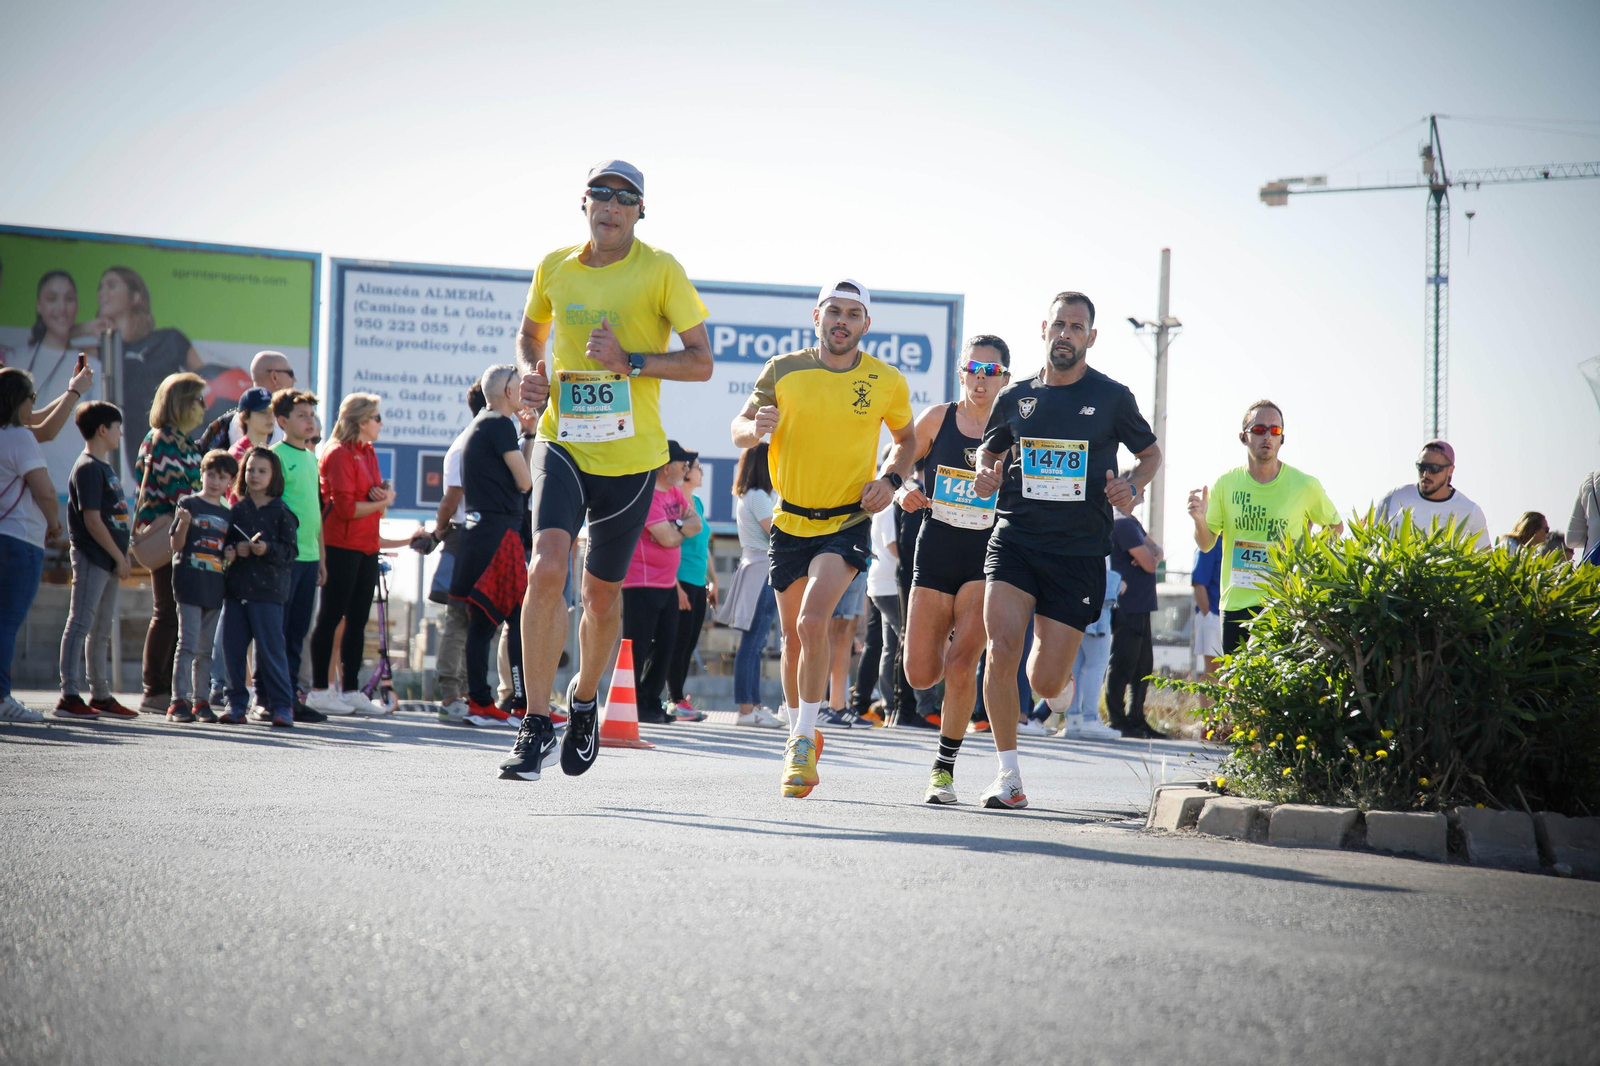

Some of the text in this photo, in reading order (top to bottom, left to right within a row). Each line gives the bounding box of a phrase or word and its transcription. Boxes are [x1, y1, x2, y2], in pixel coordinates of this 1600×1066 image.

[356, 283, 494, 302] Almacén ALMERÍA
[354, 299, 416, 315] (Camino
[421, 303, 438, 316] de
[443, 305, 459, 318] La
[465, 306, 512, 320] Goleta
[354, 316, 383, 330] 950
[388, 319, 416, 333] 222
[420, 321, 449, 335] 055
[459, 323, 466, 337] /
[476, 325, 504, 338] 629
[354, 334, 497, 354] info@prodicoyde.es
[714, 326, 922, 366] Prodiyde
[353, 369, 476, 386] Almacén ALHAM
[572, 384, 614, 404] 636
[385, 407, 413, 421] 601
[418, 409, 447, 423] 016
[1027, 449, 1081, 470] 1478
[942, 477, 992, 501] 148
[1232, 491, 1250, 504] WE
[1242, 504, 1266, 519] ARE
[1235, 517, 1288, 532] RUNNERS
[512, 665, 522, 698] joma
